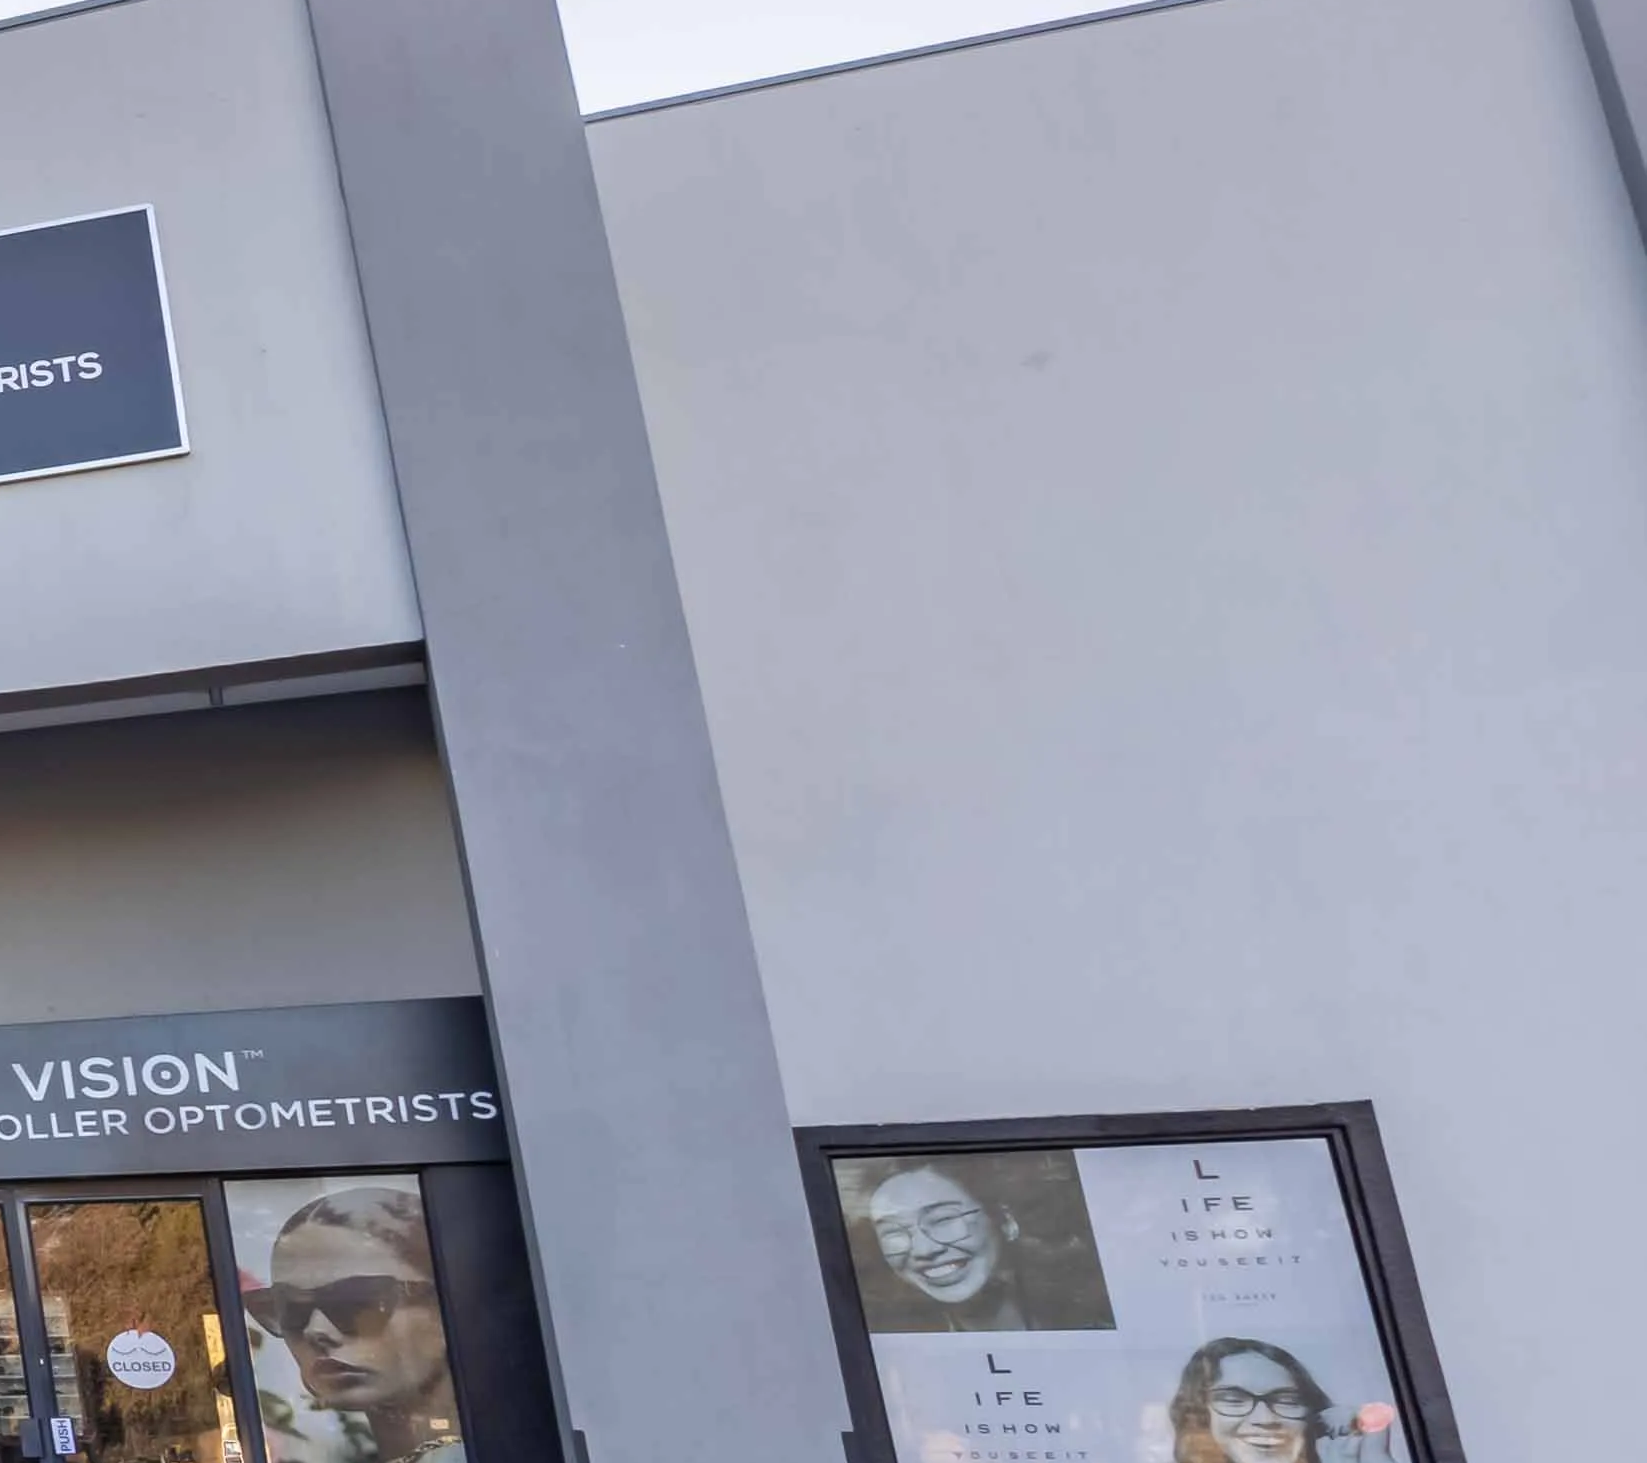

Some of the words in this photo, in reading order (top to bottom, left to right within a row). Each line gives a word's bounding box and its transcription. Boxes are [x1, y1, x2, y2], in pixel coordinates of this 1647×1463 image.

[144, 1091, 498, 1134] OPTOMETRISTS
[1193, 1159, 1220, 1180] L
[1181, 1196, 1254, 1213] IFE
[112, 1361, 172, 1373] CLOSED
[986, 1353, 1012, 1374] L
[974, 1391, 1044, 1406] IFE
[57, 1419, 72, 1453] PUSH
